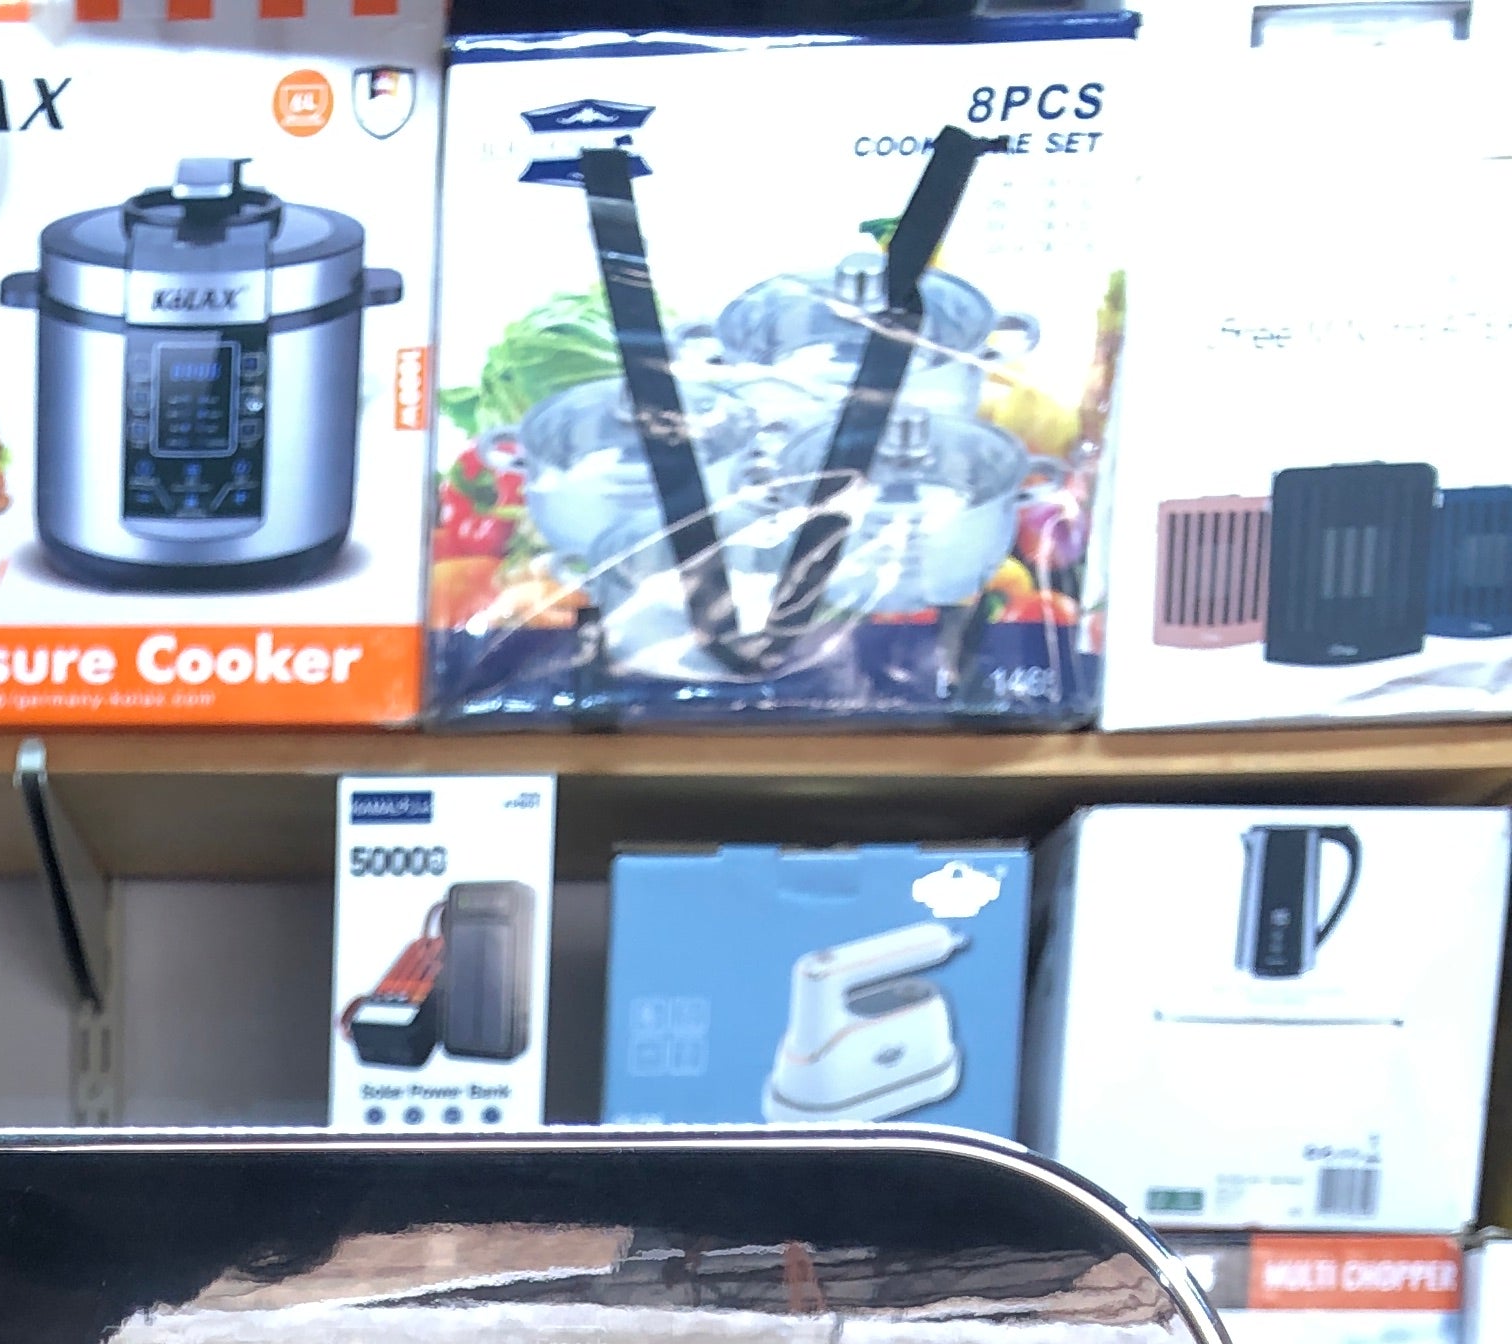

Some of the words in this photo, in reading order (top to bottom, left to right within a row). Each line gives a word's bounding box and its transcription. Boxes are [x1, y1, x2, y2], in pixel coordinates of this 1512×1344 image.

[967, 82, 1105, 123] 8PCS
[1046, 132, 1104, 153] SET
[136, 631, 363, 685] Cooker
[1264, 1260, 1337, 1290] MULTI
[1342, 1260, 1457, 1291] CHOPPER
